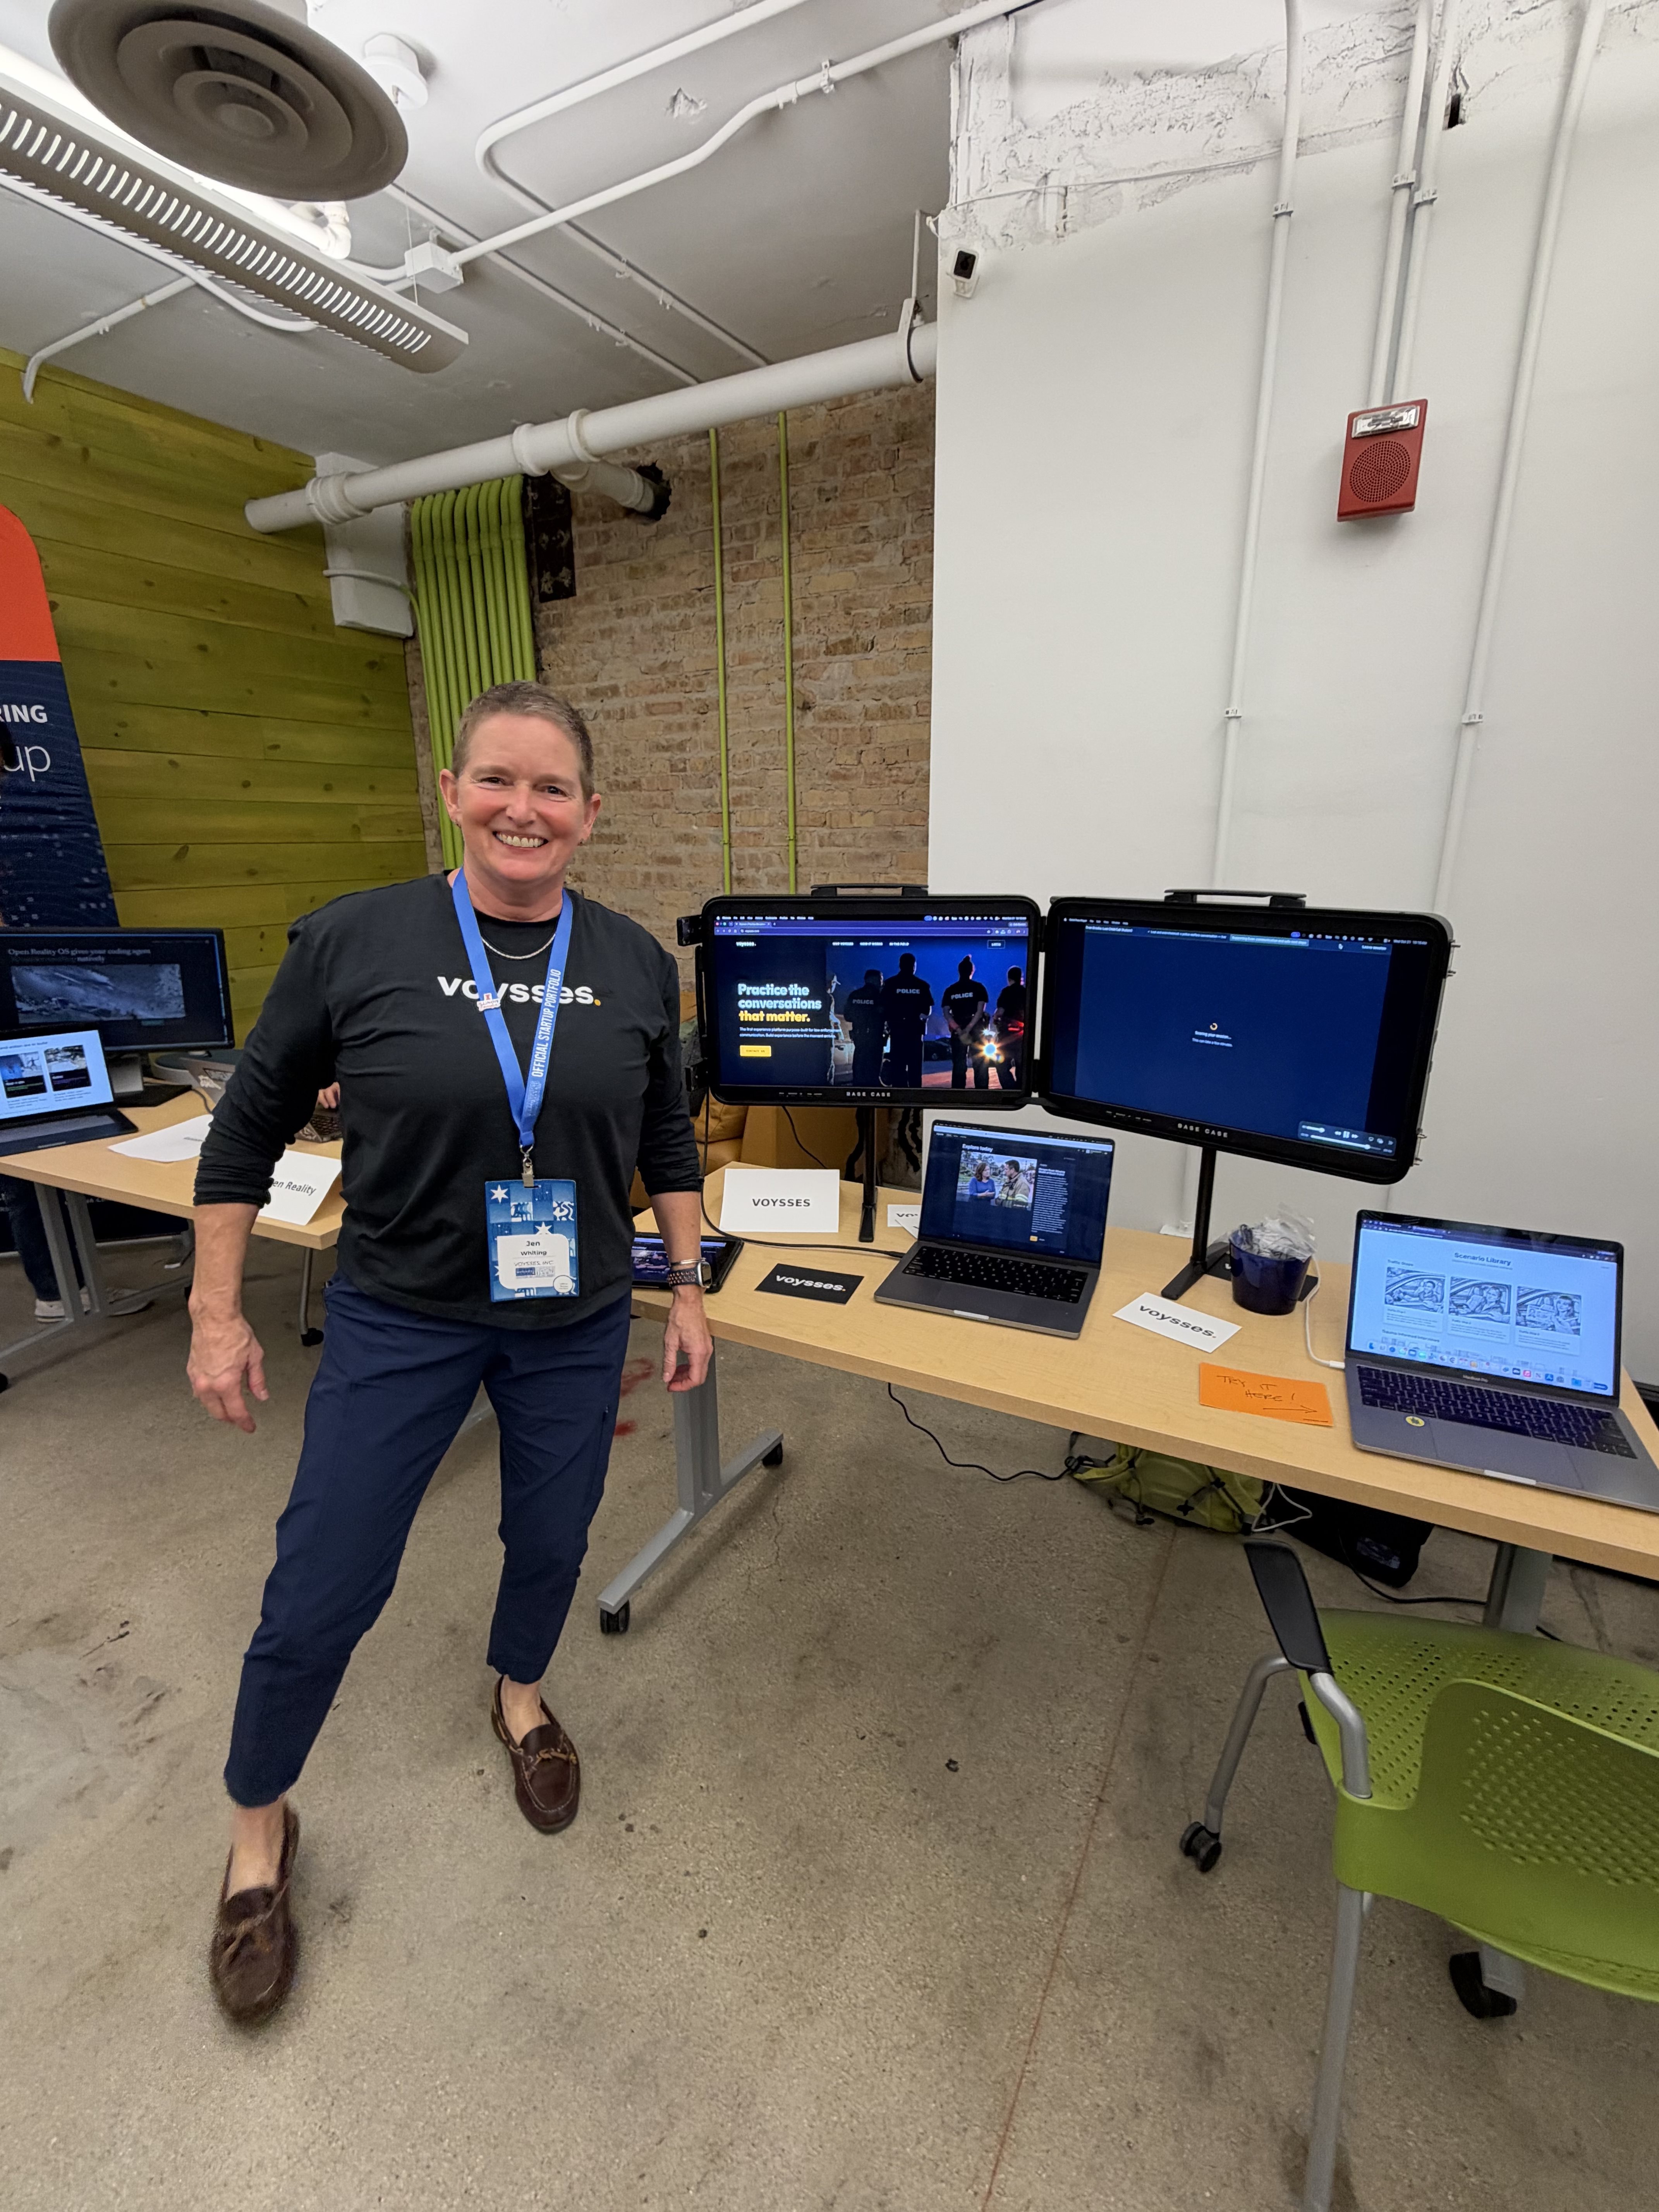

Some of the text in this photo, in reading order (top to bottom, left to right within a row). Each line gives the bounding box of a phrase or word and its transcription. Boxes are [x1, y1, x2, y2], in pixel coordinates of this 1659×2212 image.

[0, 704, 48, 723] ING
[3, 746, 51, 782] up
[544, 969, 562, 1007] PORTFOLIO
[738, 983, 809, 996] Practice the
[738, 997, 822, 1009] conversations
[739, 1010, 811, 1022] that matter.
[538, 1008, 555, 1041] STARTUP
[531, 1042, 549, 1078] OFFICIAL
[285, 1181, 316, 1196] Reality
[752, 1198, 811, 1207] VOYSSES
[1454, 1252, 1485, 1262] Scenario
[1486, 1257, 1511, 1266] Library
[776, 1274, 846, 1292] voysses.
[1139, 1305, 1217, 1339] voysses.
[1216, 1375, 1246, 1388] TRY
